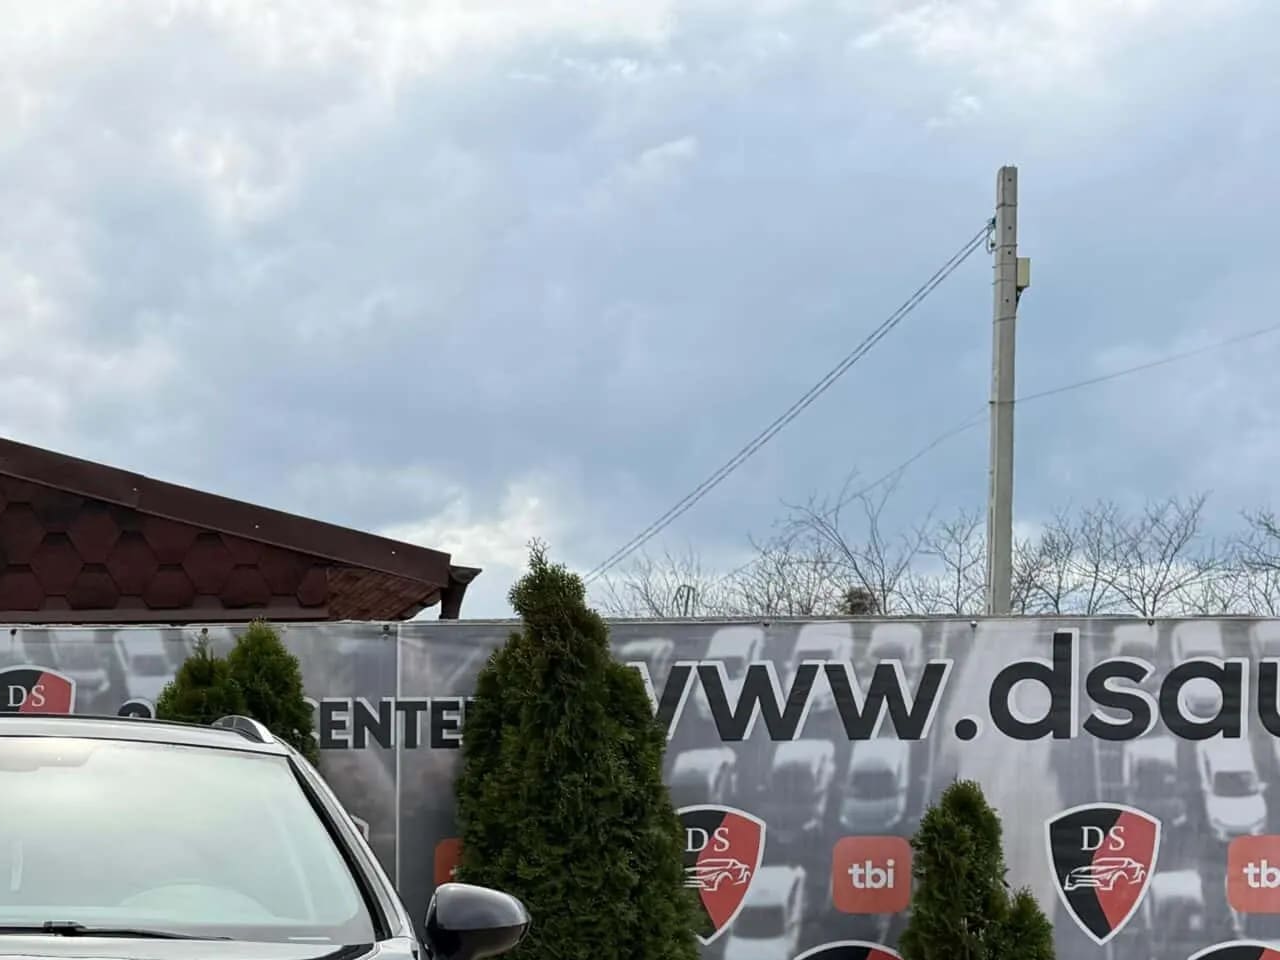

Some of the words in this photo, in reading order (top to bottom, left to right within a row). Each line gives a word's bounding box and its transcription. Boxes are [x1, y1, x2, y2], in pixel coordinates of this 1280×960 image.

[7, 684, 47, 708] DS
[627, 629, 1280, 741] ww.dsa
[306, 697, 478, 750] ENTE
[686, 827, 730, 853] DS
[1080, 825, 1125, 852] DS
[848, 859, 896, 889] tbi
[1243, 859, 1280, 889] tb
